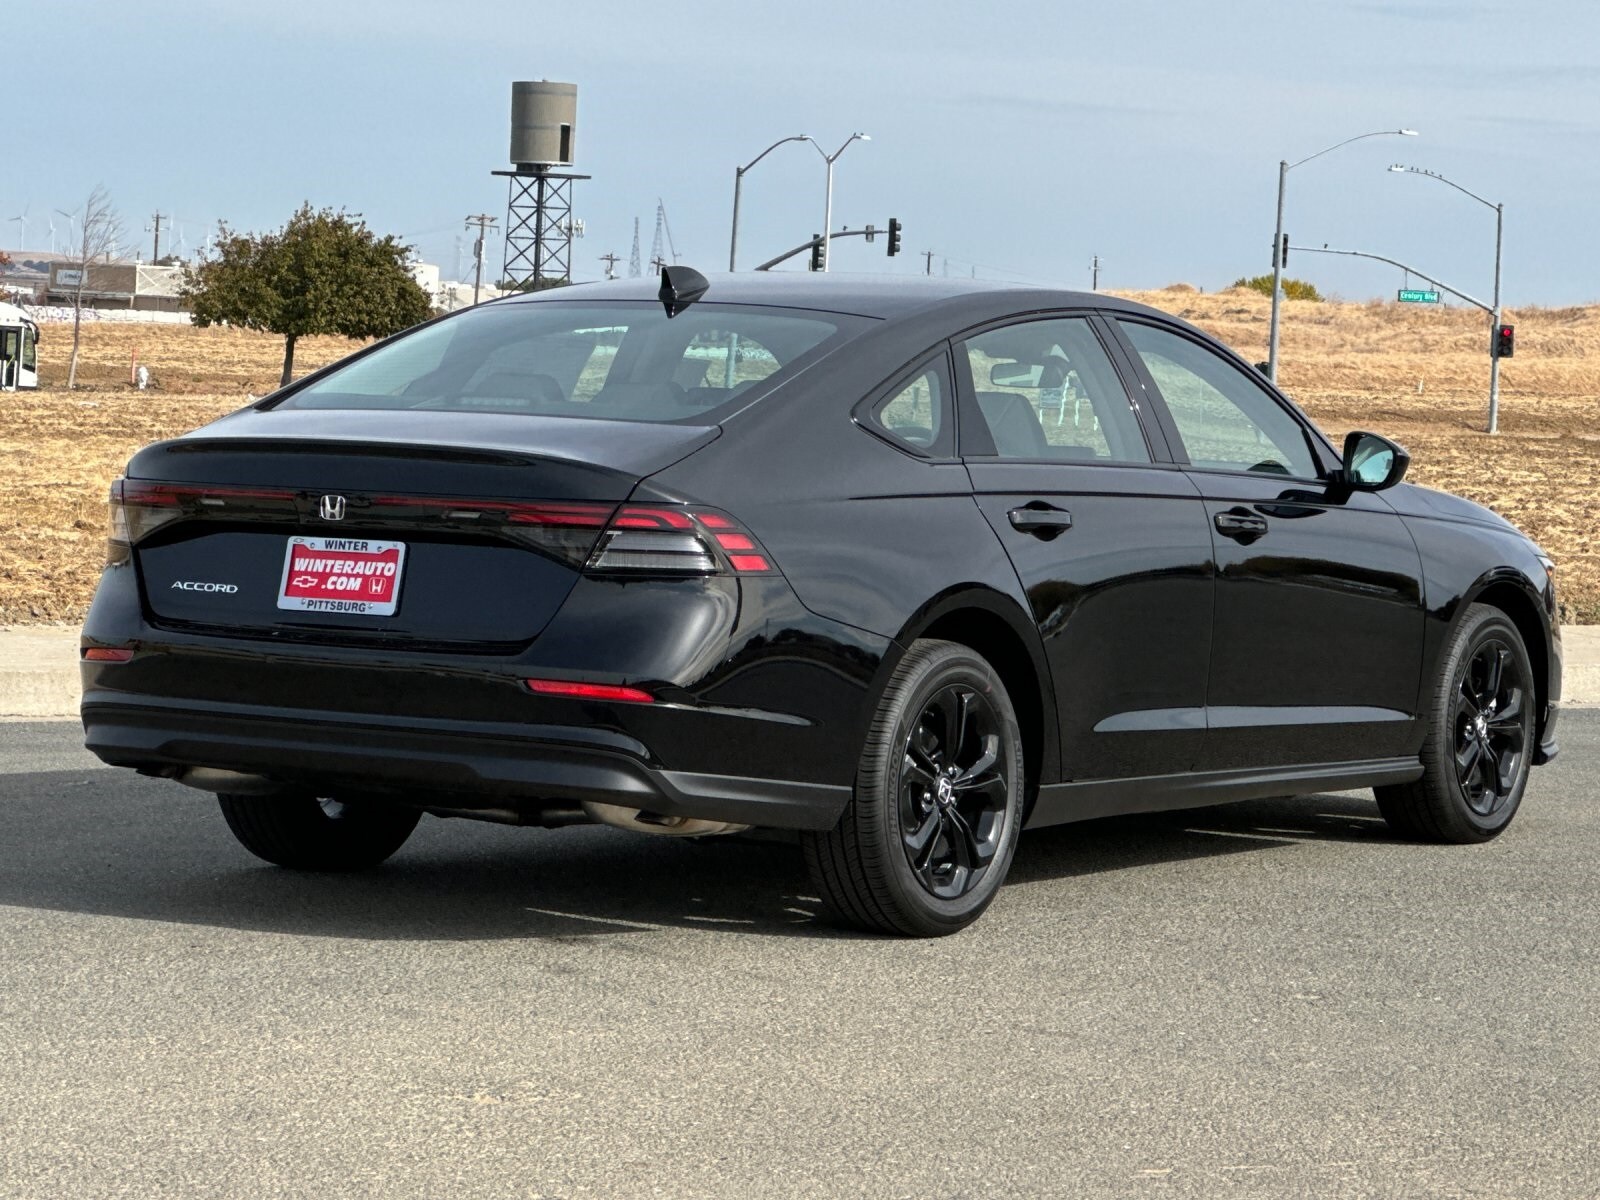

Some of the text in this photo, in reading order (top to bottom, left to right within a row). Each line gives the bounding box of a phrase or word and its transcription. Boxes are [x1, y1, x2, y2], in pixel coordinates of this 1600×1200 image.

[1424, 292, 1438, 301] Blvd
[324, 540, 368, 551] WINTER
[294, 558, 395, 576] WINTERAUTO
[171, 580, 239, 593] ACCORD
[321, 576, 362, 591] .COM
[306, 600, 366, 612] PITTSBURG
